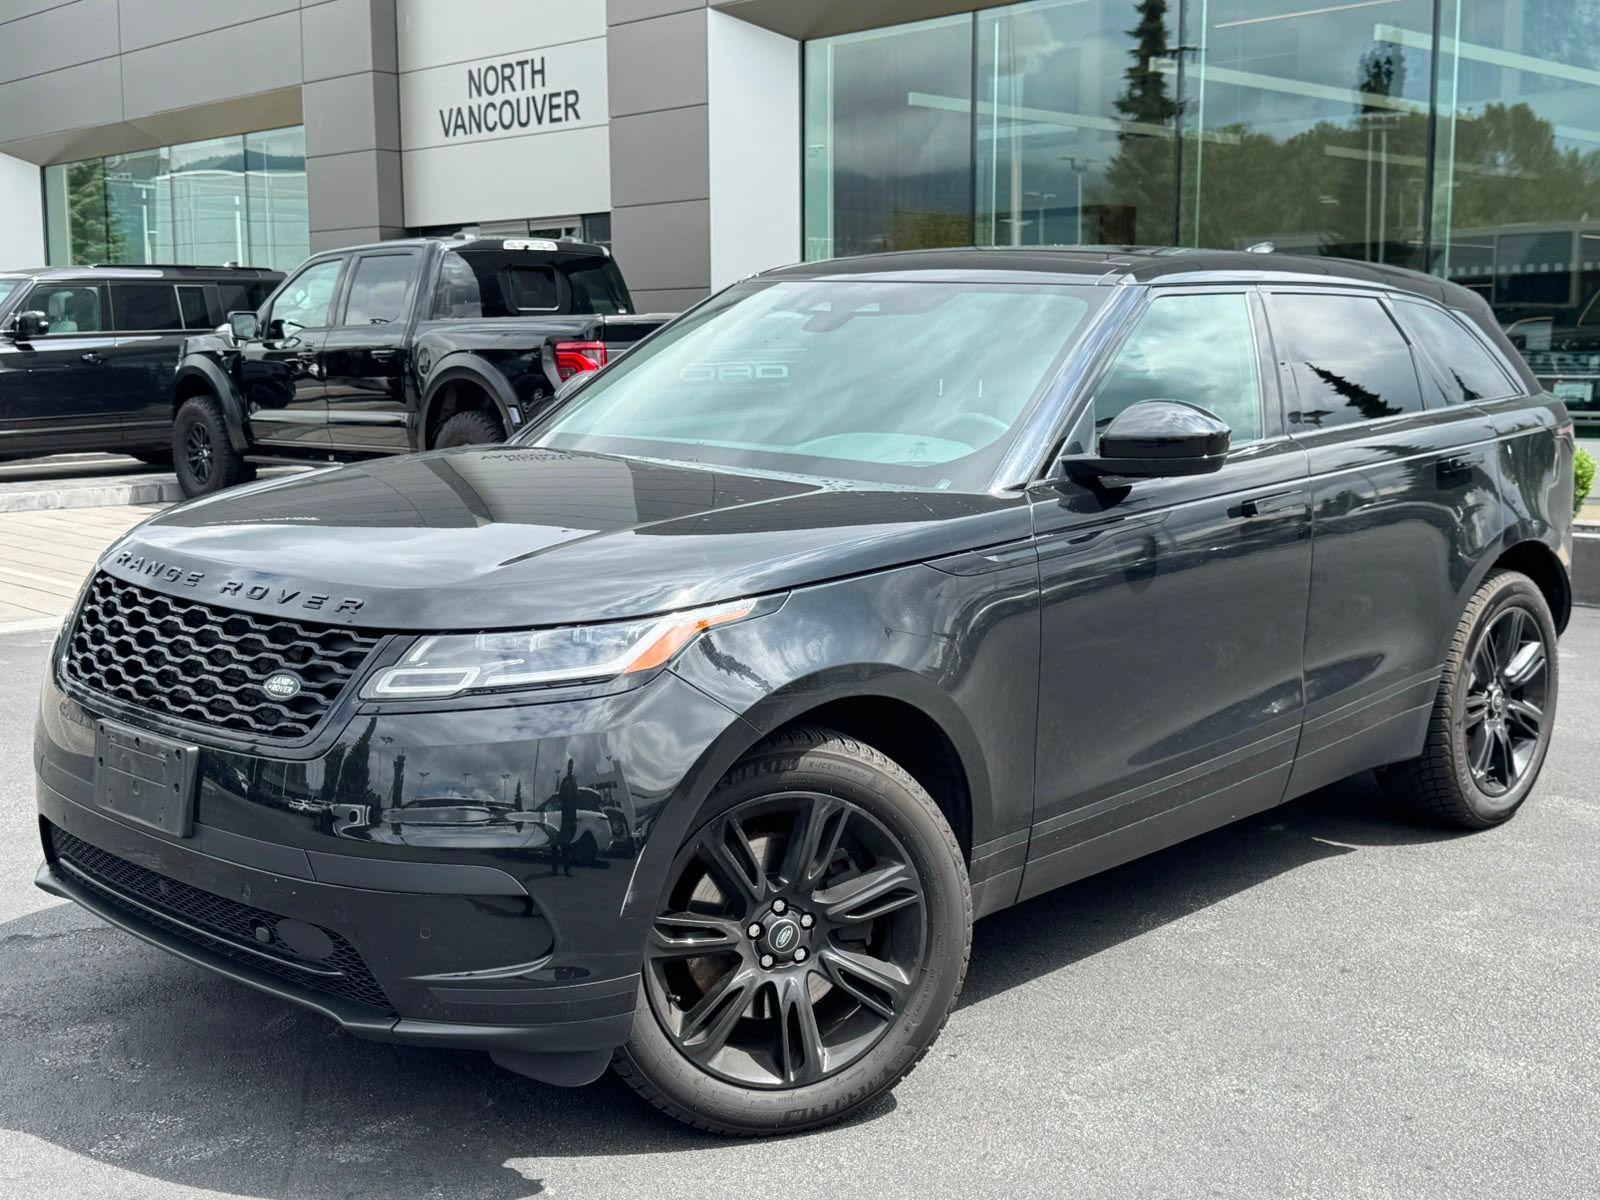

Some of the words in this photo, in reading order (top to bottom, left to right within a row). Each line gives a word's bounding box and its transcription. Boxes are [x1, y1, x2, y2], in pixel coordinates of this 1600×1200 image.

[468, 57, 545, 99] NORTH
[439, 89, 581, 138] VANCOUVER
[116, 550, 205, 588] RANGE
[219, 580, 365, 615] ROVER
